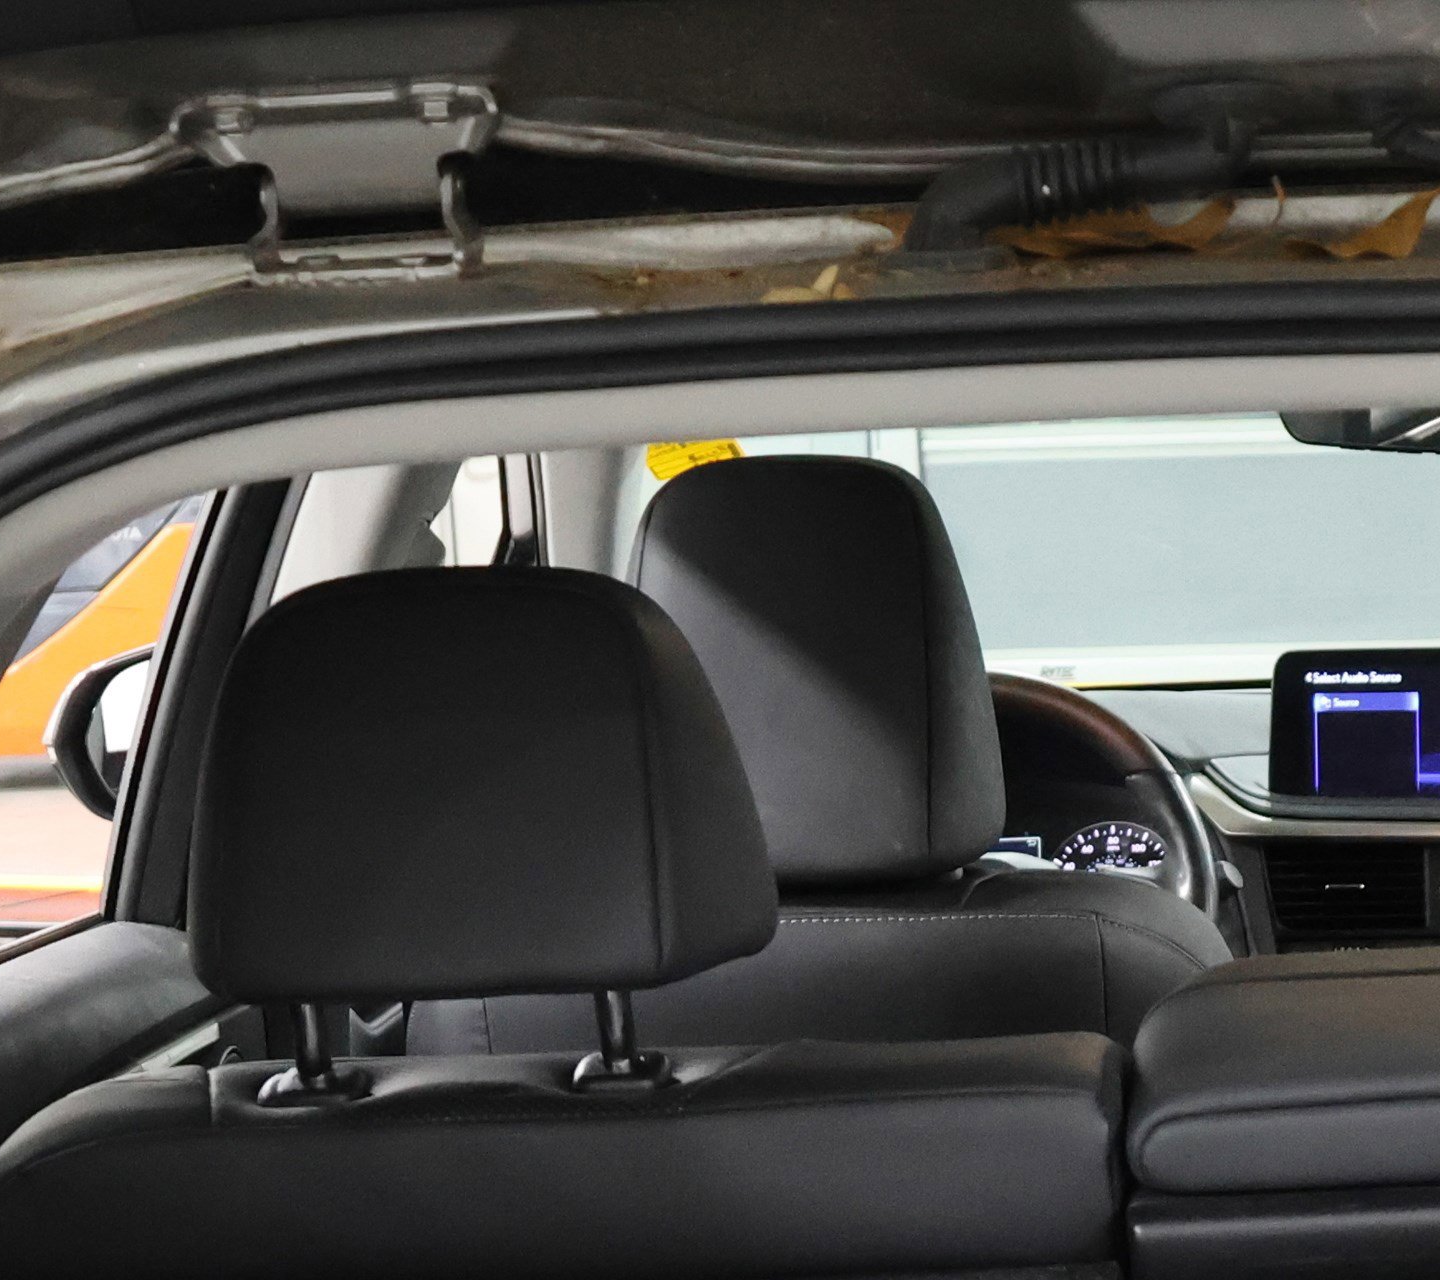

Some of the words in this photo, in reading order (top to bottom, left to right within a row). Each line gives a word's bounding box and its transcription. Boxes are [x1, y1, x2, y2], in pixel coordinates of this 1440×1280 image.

[1313, 672, 1341, 684] Select
[1342, 672, 1369, 683] Audio
[1370, 671, 1402, 683] Source
[1333, 697, 1360, 708] Source
